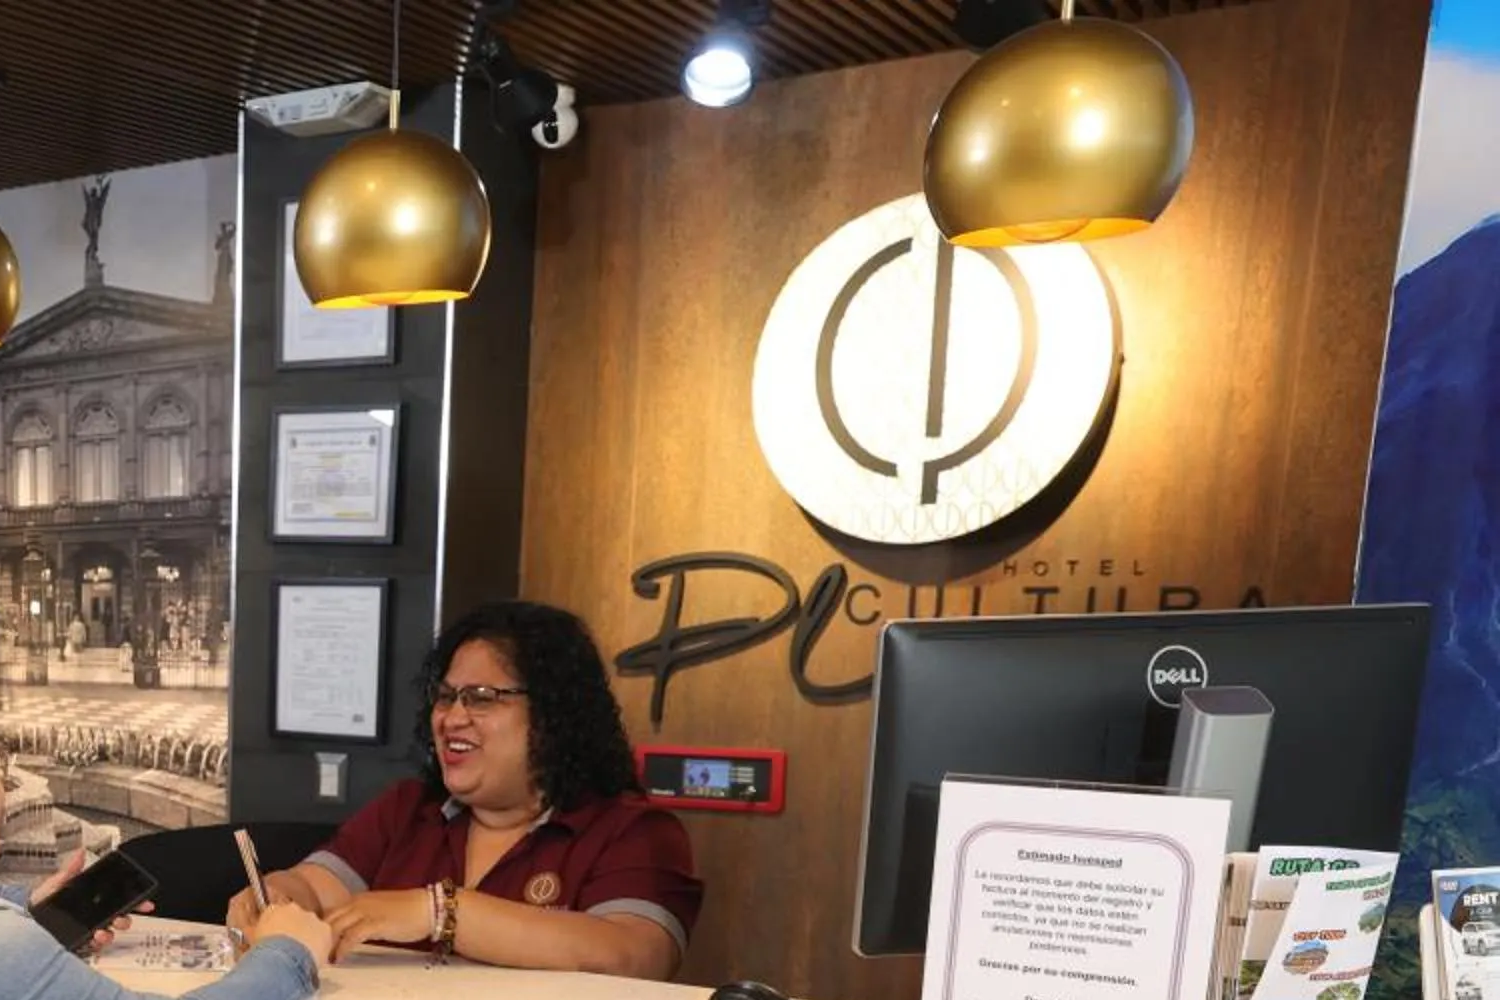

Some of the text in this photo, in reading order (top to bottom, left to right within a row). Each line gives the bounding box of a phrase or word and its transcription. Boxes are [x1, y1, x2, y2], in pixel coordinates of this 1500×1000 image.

[1003, 560, 1144, 577] HOTEL
[1154, 667, 1201, 685] DELL
[1270, 857, 1325, 876] RUTA
[1463, 891, 1499, 907] RENT
